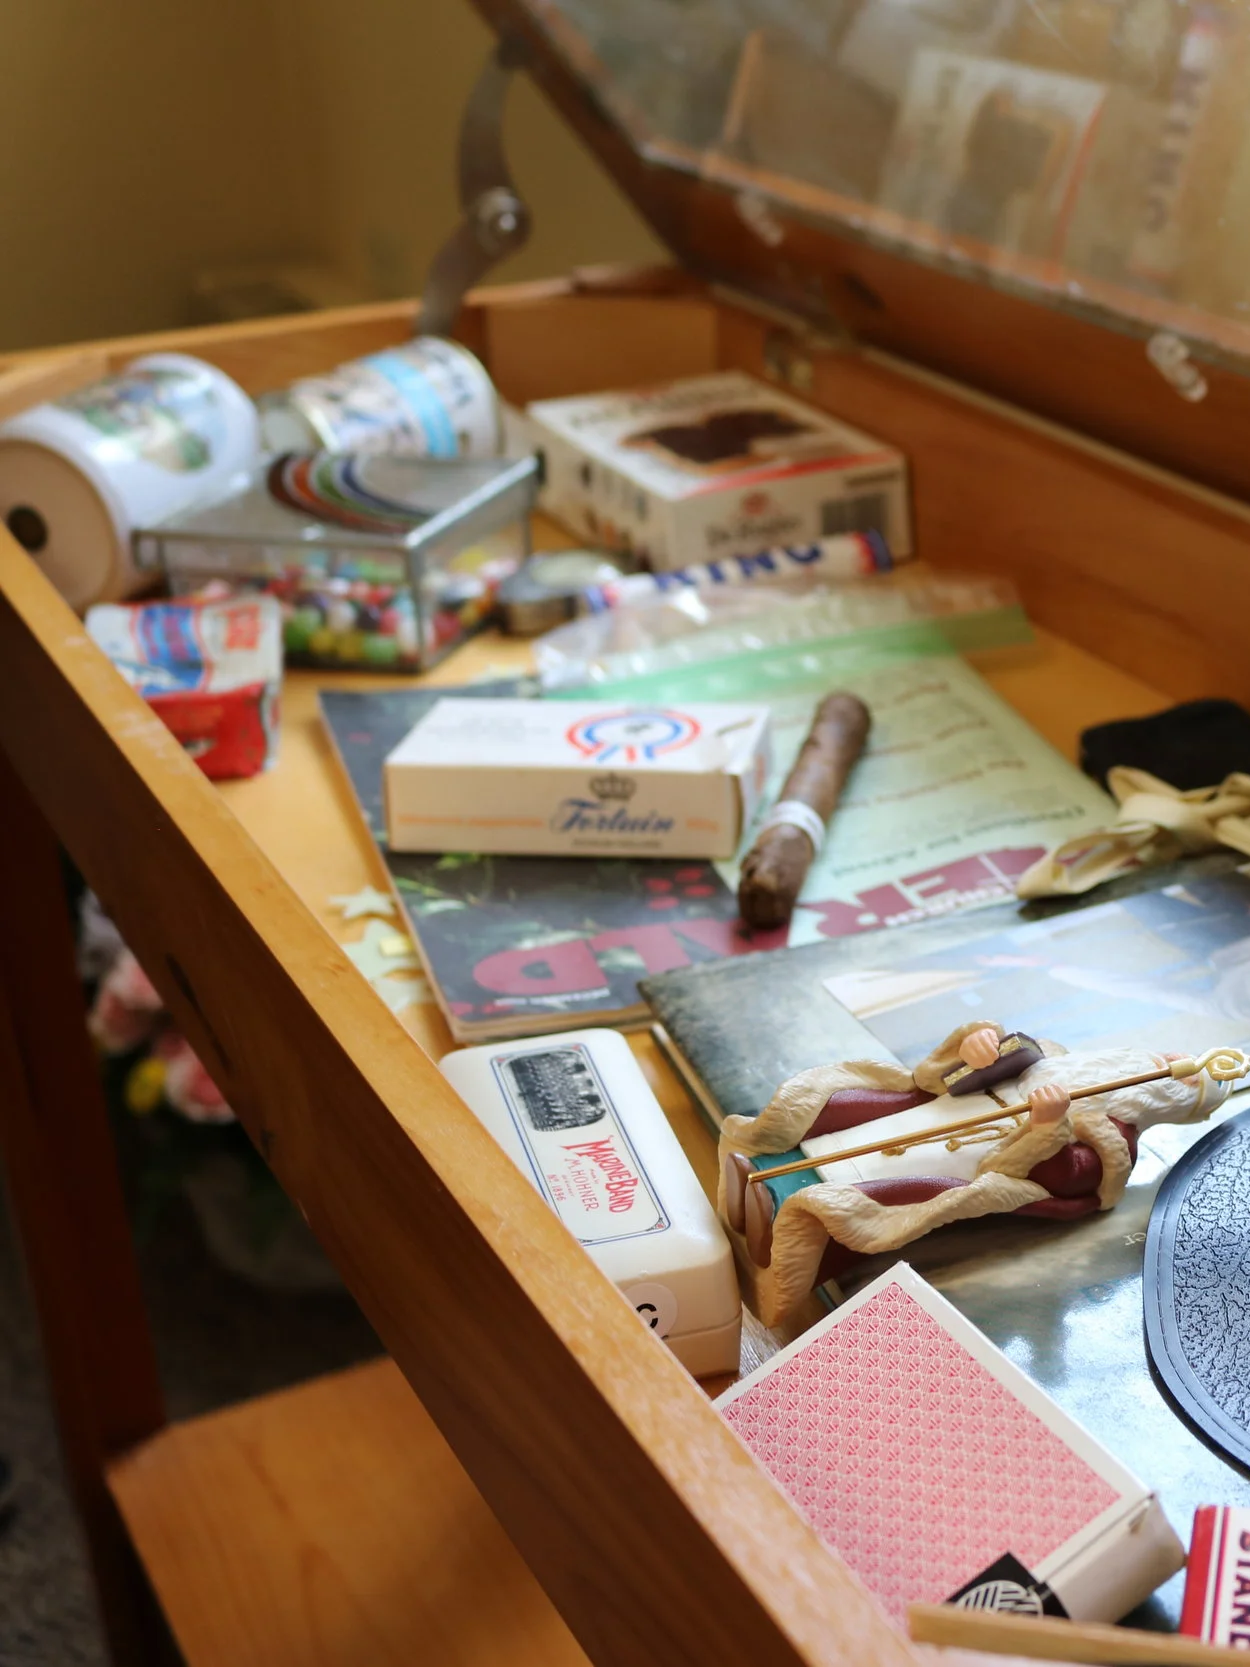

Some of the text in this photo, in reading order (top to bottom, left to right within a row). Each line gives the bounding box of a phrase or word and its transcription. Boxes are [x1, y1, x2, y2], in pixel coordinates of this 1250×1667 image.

[562, 1134, 638, 1213] MARINE BAND
[571, 1169, 600, 1212] HOHNER
